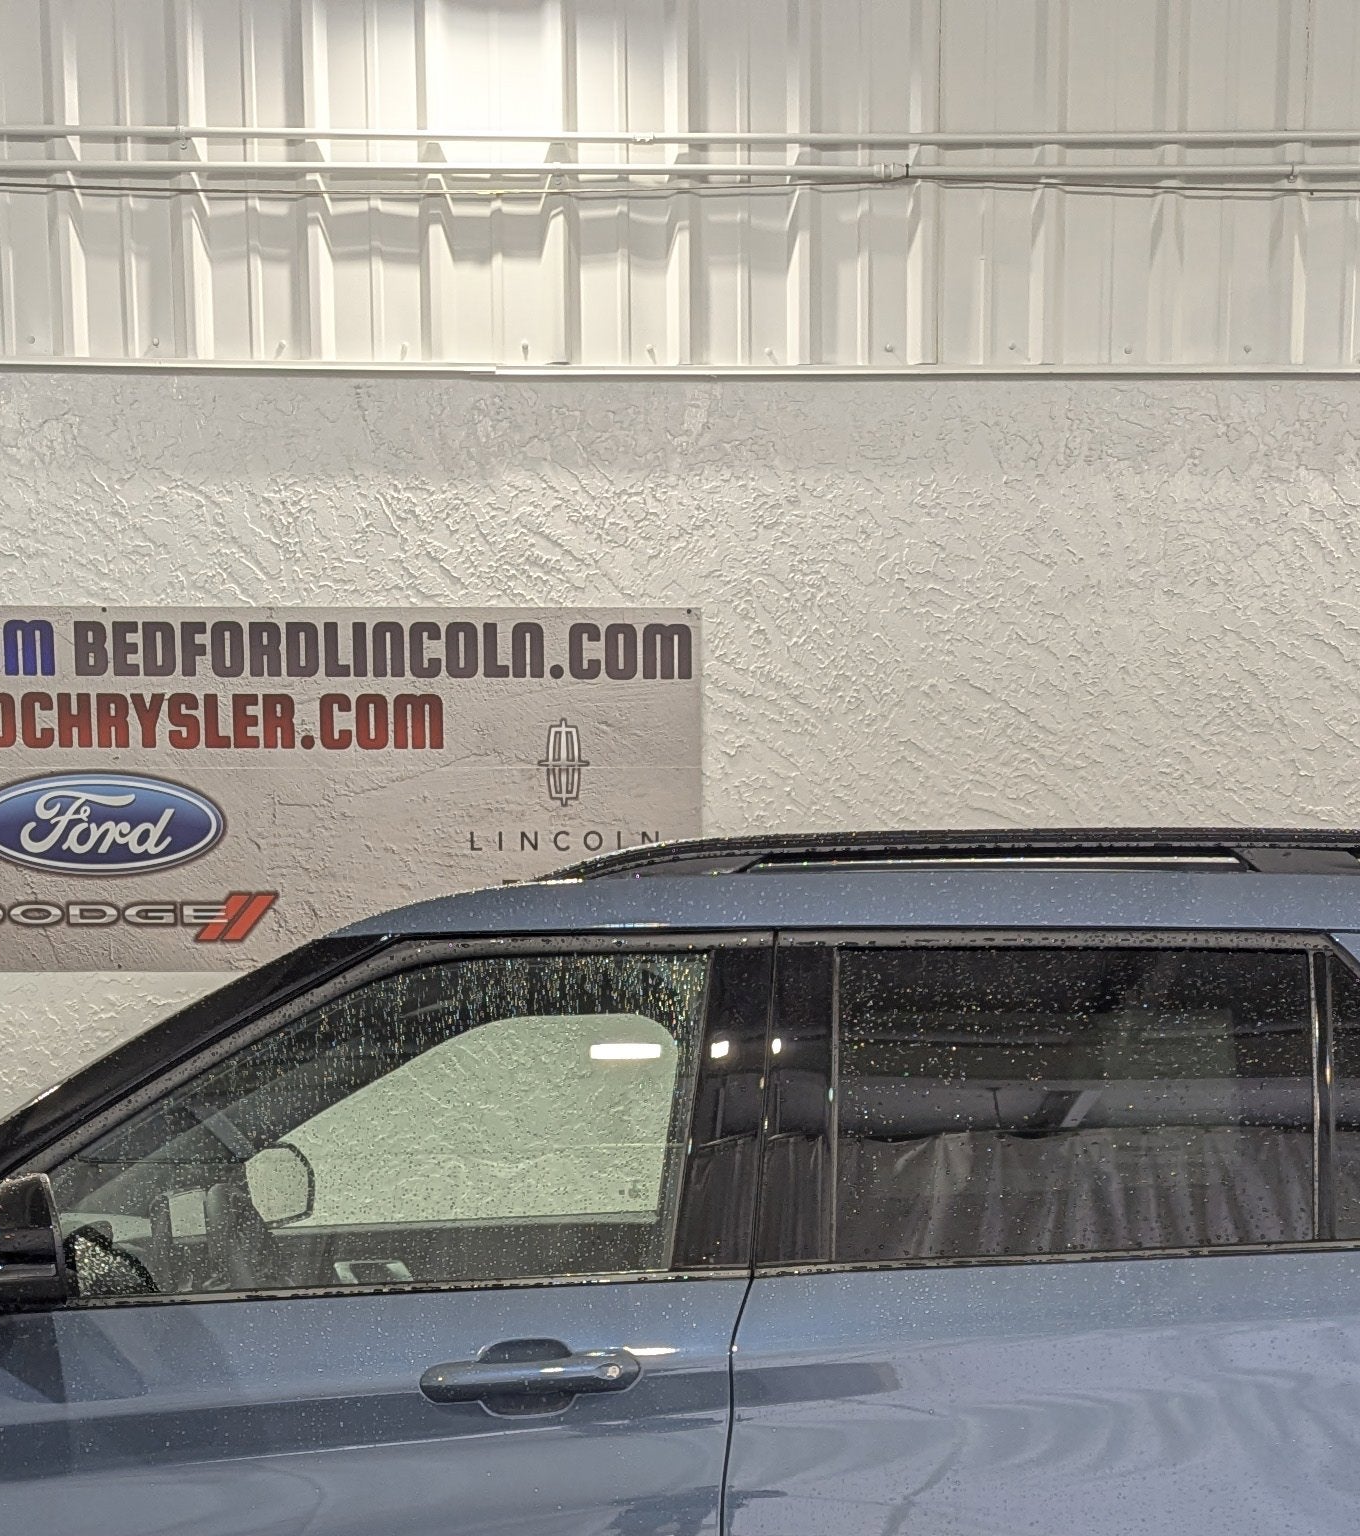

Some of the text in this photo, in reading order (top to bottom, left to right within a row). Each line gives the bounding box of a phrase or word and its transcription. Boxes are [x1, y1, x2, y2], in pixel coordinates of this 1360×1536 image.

[73, 619, 693, 681] BEDFORDLINCOLN.COM
[20, 789, 176, 854] Ford
[469, 830, 660, 851] LINCOLN
